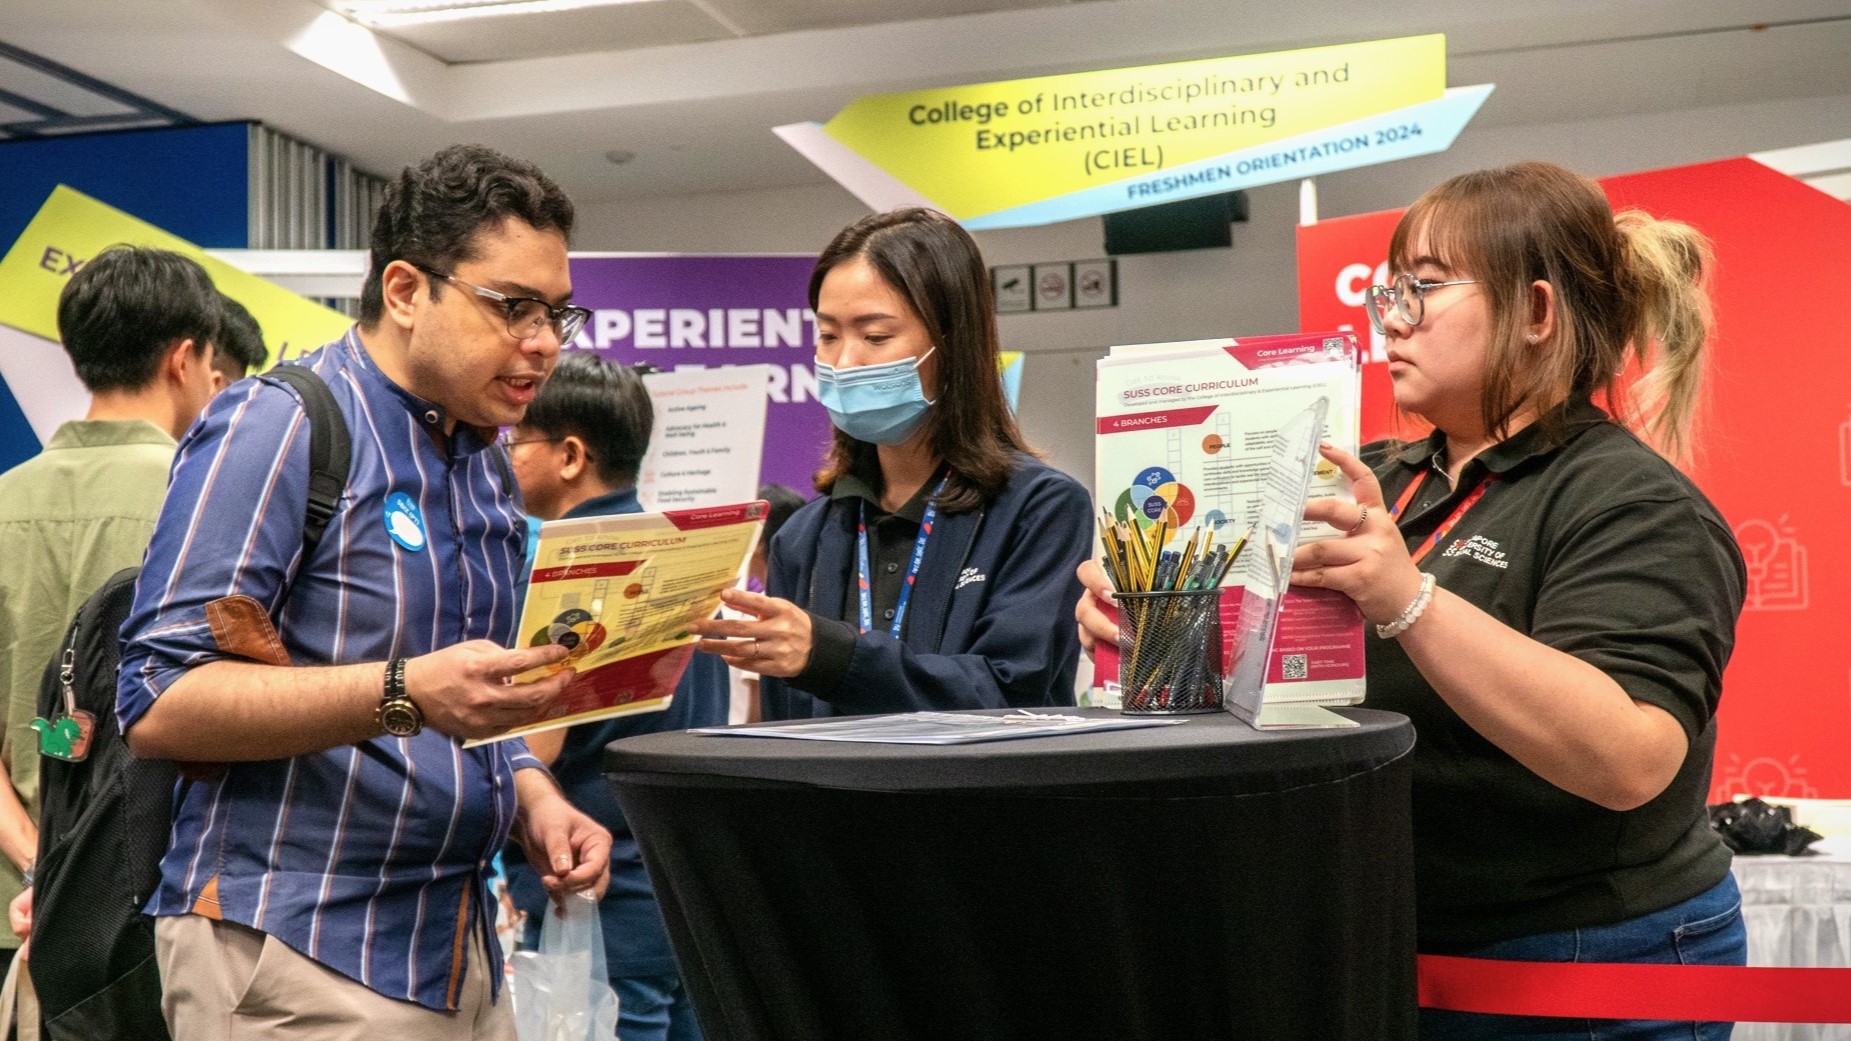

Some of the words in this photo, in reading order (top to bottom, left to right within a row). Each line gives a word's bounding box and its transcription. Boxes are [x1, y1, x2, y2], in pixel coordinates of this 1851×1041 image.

[909, 101, 1009, 125] College
[1018, 93, 1043, 115] of
[1053, 73, 1284, 112] Interdisciplinary
[1295, 62, 1350, 87] and
[976, 115, 1140, 151] Experiential
[1151, 105, 1276, 133] Learning
[1085, 145, 1164, 175] (CIEL)
[1127, 164, 1231, 199] FRESHMEN
[1237, 135, 1369, 175] ORIENTATION
[1375, 122, 1423, 146] 2024
[1278, 346, 1315, 355] Learning
[1123, 388, 1151, 400] SUSS
[1152, 385, 1183, 396] CORE
[1185, 378, 1259, 393] CURRICULUM
[1121, 416, 1168, 427] BRANCHES
[588, 542, 617, 552] CORE
[620, 537, 686, 550] CURRICULUM
[1473, 552, 1509, 569] SCIENCES
[1494, 552, 1506, 560] OF
